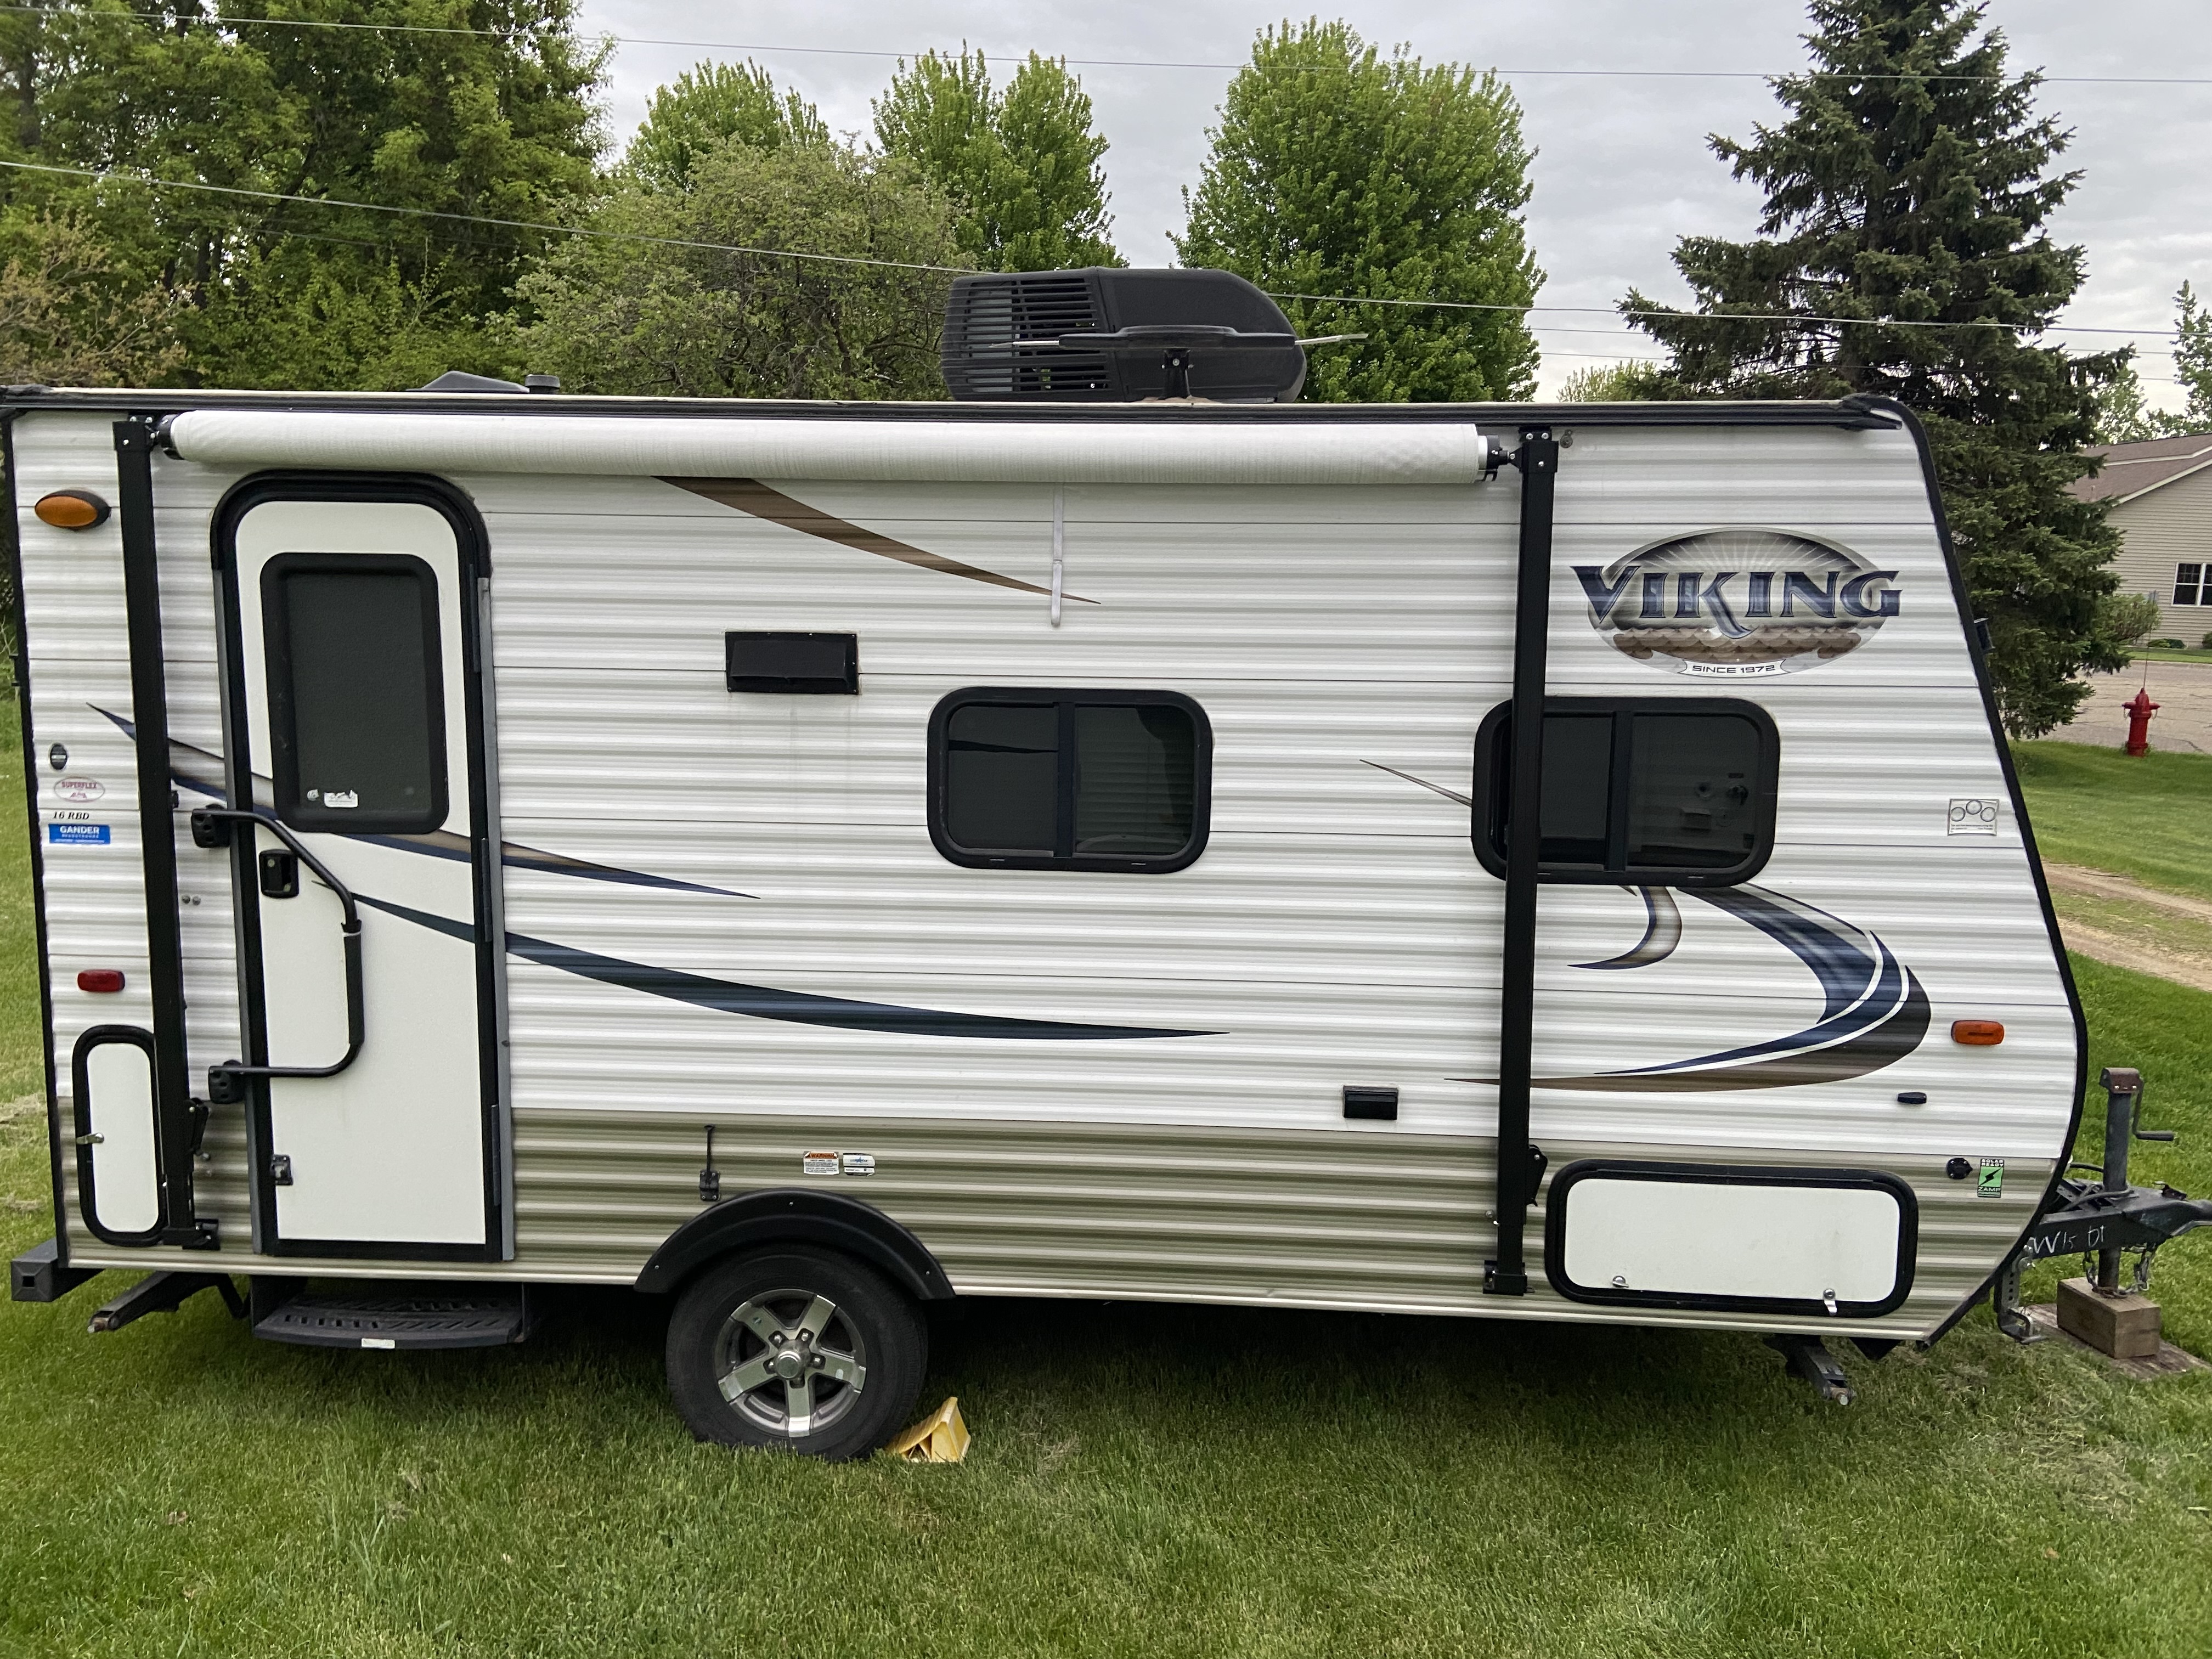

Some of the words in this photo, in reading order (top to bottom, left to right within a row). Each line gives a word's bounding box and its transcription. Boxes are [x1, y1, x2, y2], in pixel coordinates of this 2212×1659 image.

[1570, 565, 1903, 639] VIKING
[1692, 664, 1737, 674] SINCE
[1740, 664, 1776, 674] 1972
[53, 811, 65, 820] 16
[67, 811, 89, 820] RBD
[60, 825, 100, 834] GANDER
